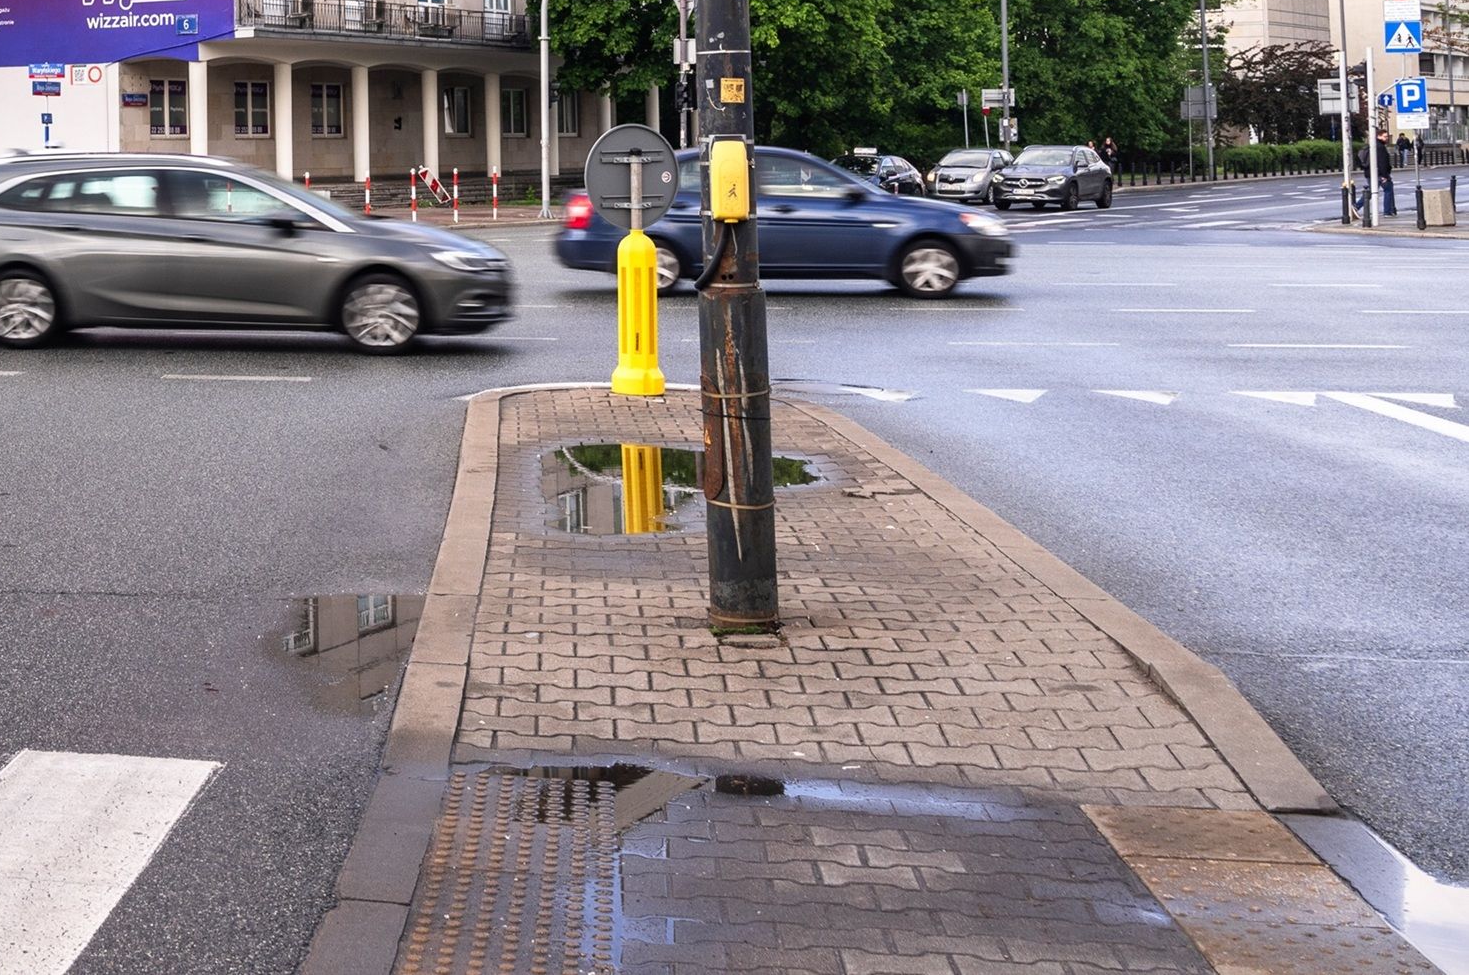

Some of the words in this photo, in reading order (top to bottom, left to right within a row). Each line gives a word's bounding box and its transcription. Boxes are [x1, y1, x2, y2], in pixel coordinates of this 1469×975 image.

[86, 12, 175, 29] wizzair.com
[183, 19, 190, 30] 6
[1401, 84, 1421, 108] P
